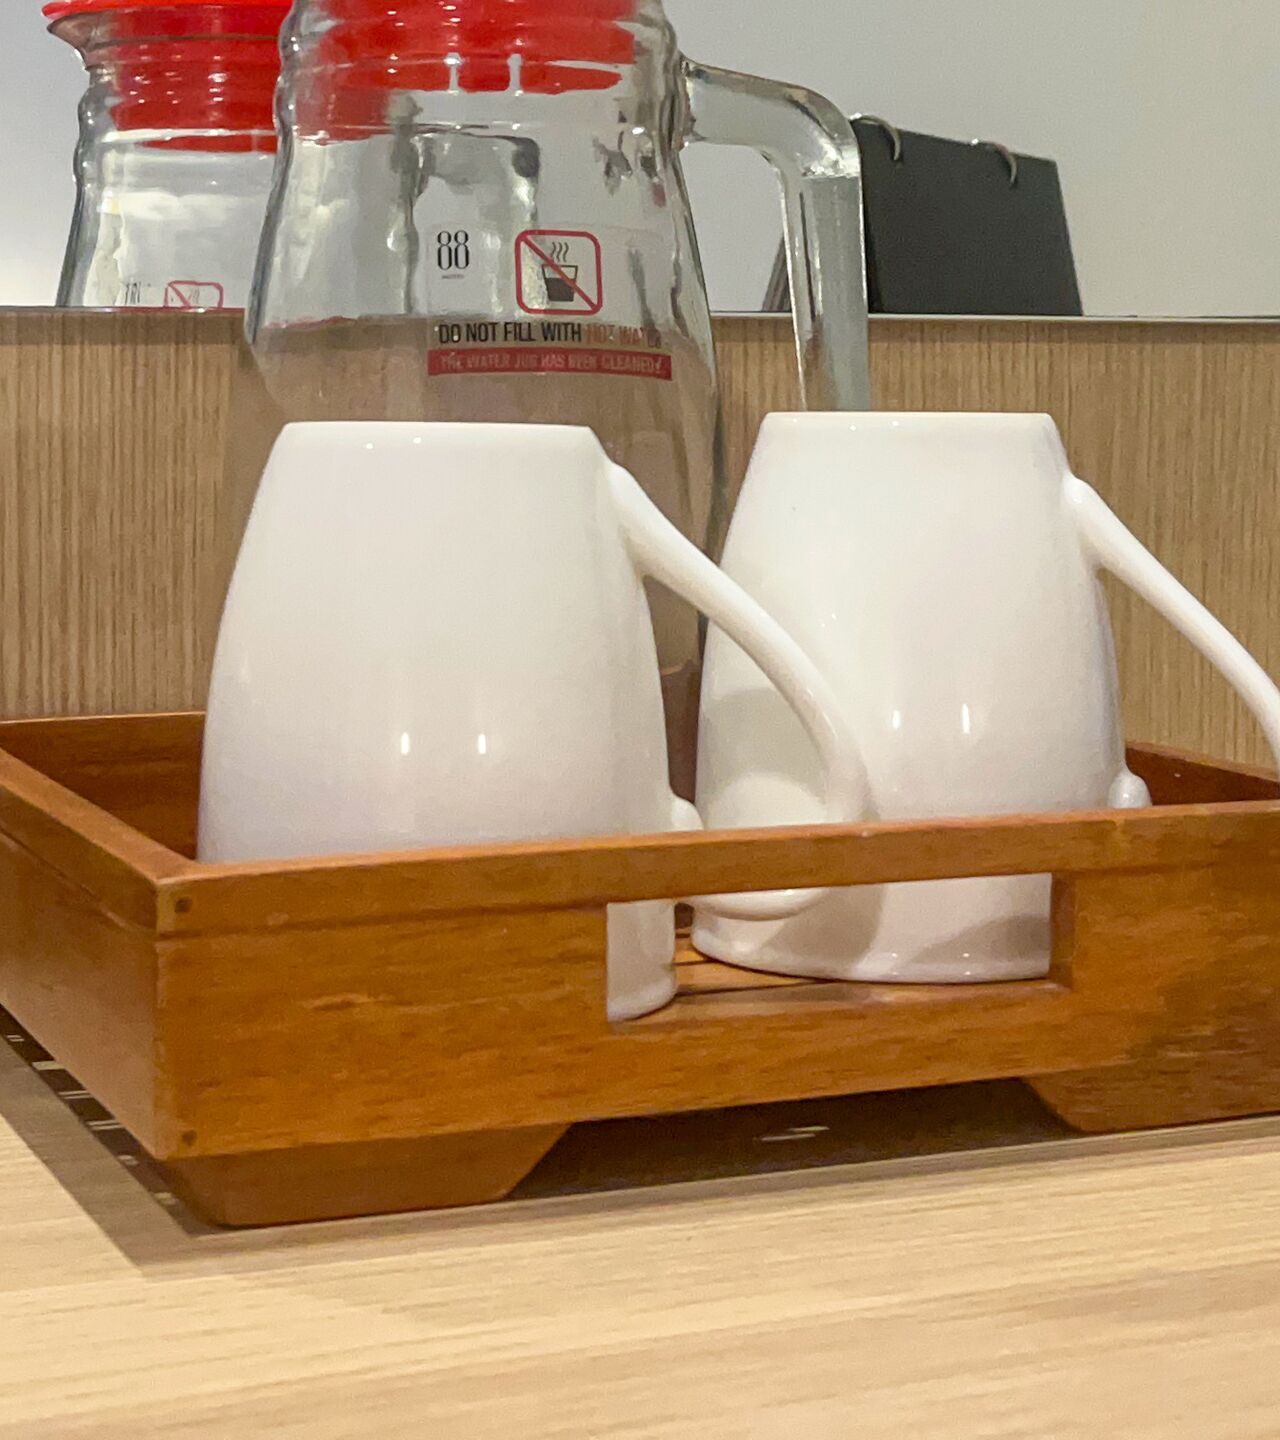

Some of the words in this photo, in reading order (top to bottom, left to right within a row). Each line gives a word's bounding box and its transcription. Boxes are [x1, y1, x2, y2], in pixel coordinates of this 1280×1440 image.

[437, 230, 470, 270] 88
[439, 324, 462, 343] DO
[466, 322, 500, 342] NOT
[504, 321, 536, 342] FILL
[542, 322, 582, 342] WITH
